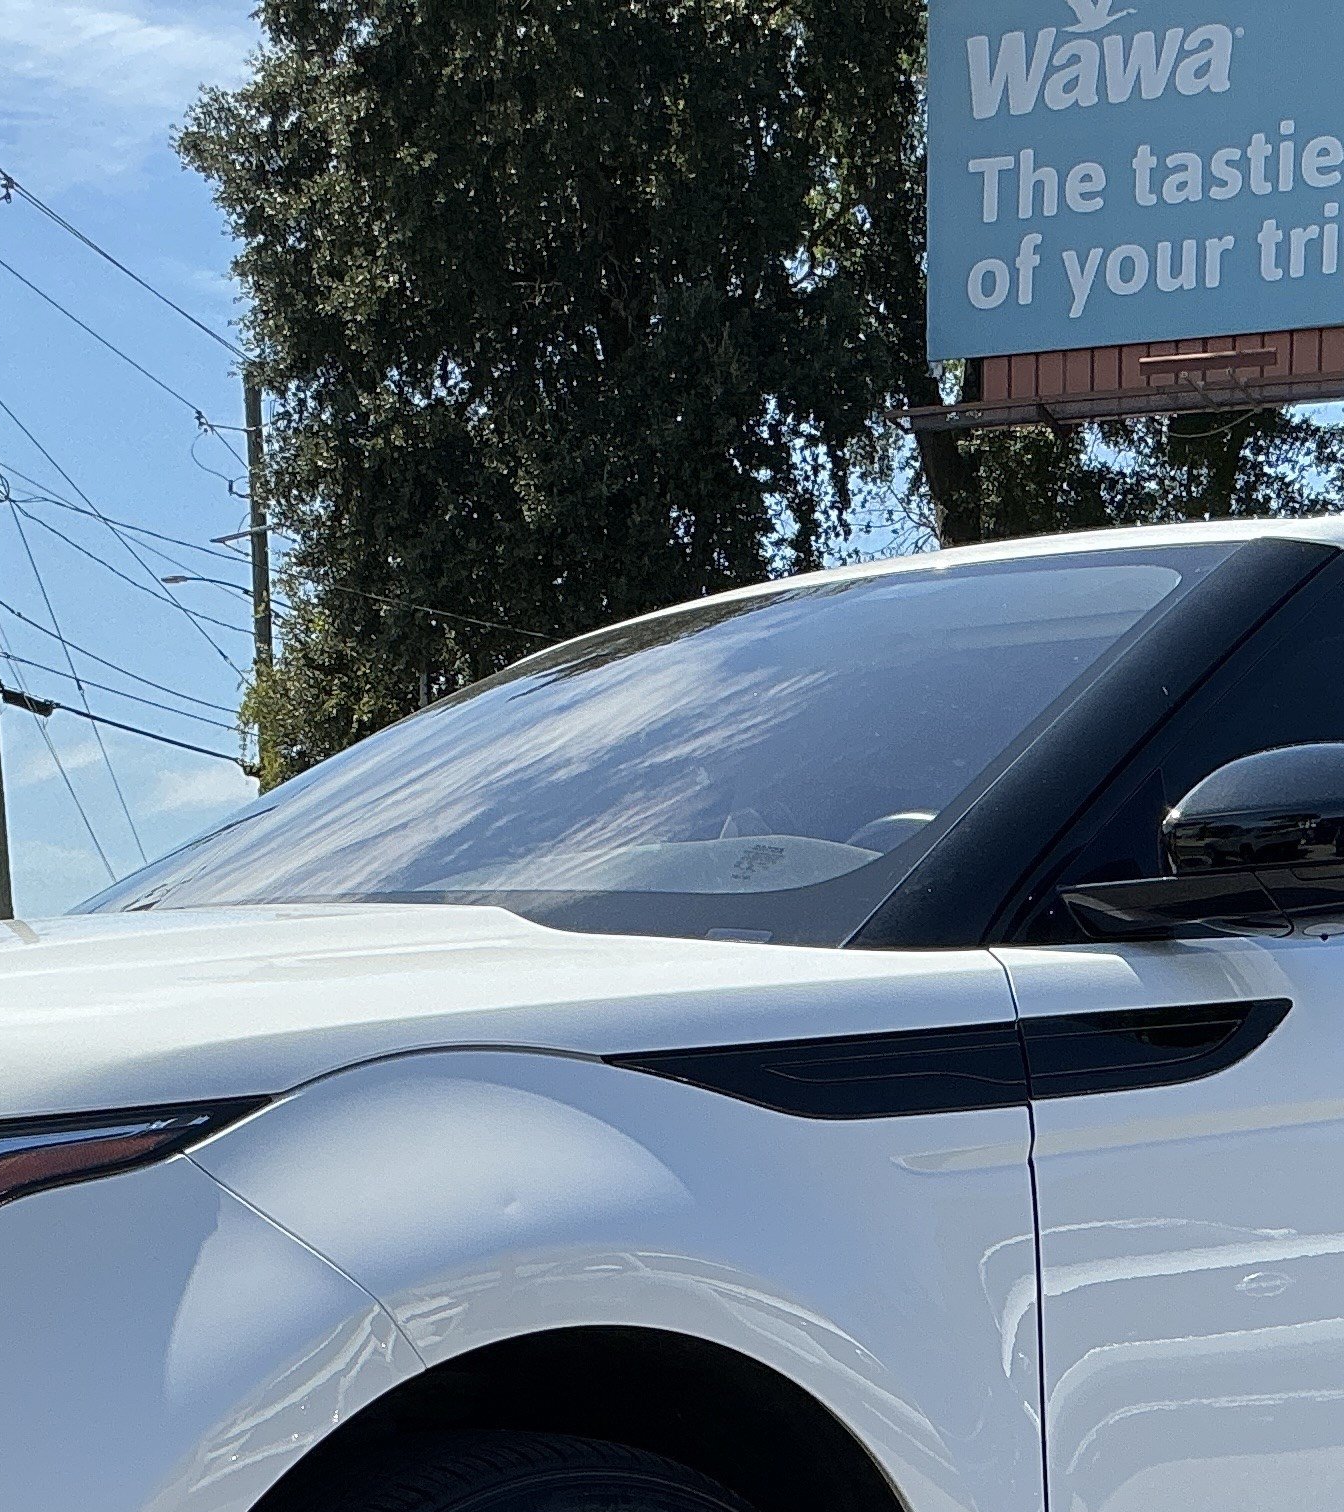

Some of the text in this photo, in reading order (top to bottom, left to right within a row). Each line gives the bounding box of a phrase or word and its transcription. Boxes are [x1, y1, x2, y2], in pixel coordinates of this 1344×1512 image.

[966, 23, 1235, 121] Wawa
[967, 148, 1106, 223] The
[966, 233, 1043, 311] of
[1061, 233, 1235, 320] your
